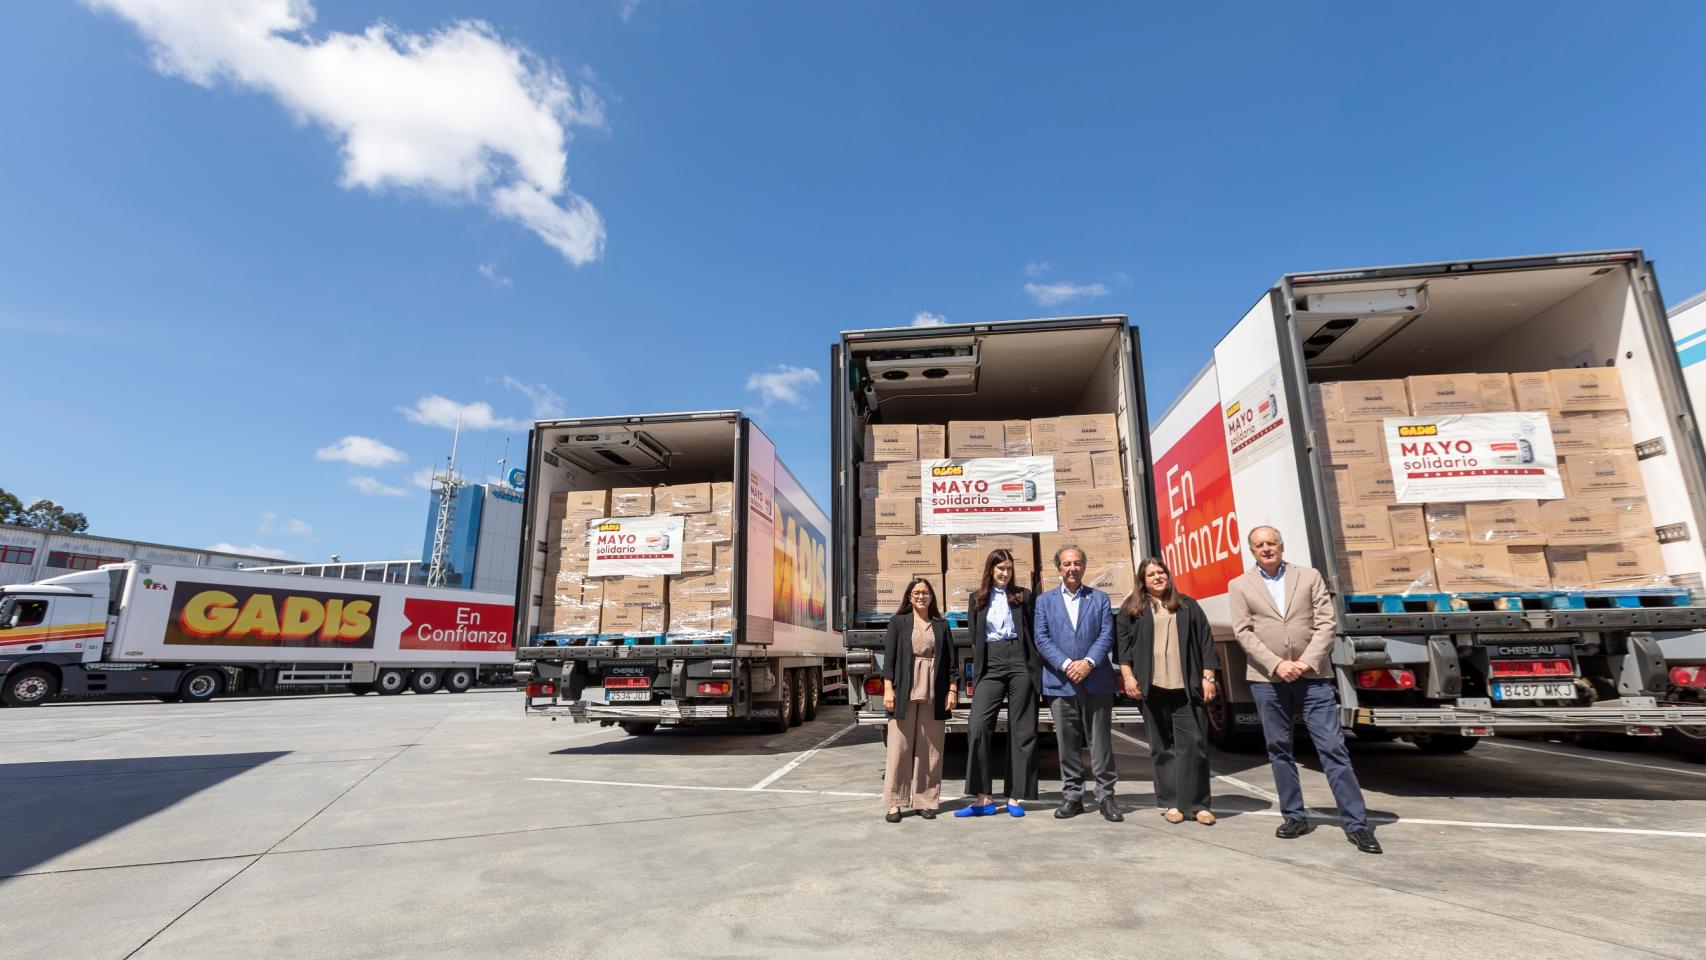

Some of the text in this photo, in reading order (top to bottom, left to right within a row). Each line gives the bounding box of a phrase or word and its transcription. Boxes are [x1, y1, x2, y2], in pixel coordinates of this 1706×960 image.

[1228, 408, 1254, 435] MAYO
[1399, 425, 1437, 437] GADIS
[1401, 440, 1473, 457] MAYO
[1404, 456, 1478, 470] solidario
[933, 466, 962, 476] GADIS
[933, 480, 989, 494] MAYO
[1167, 464, 1195, 519] En
[932, 494, 990, 506] solidario
[597, 534, 637, 545] MAYO
[596, 545, 636, 554] solidario
[183, 591, 372, 639] GADIS
[457, 607, 480, 625] En
[417, 624, 507, 643] Confianza
[1499, 646, 1554, 655] CHEREAU
[611, 692, 631, 700] 2534
[1504, 684, 1572, 697] 8487 MKJ
